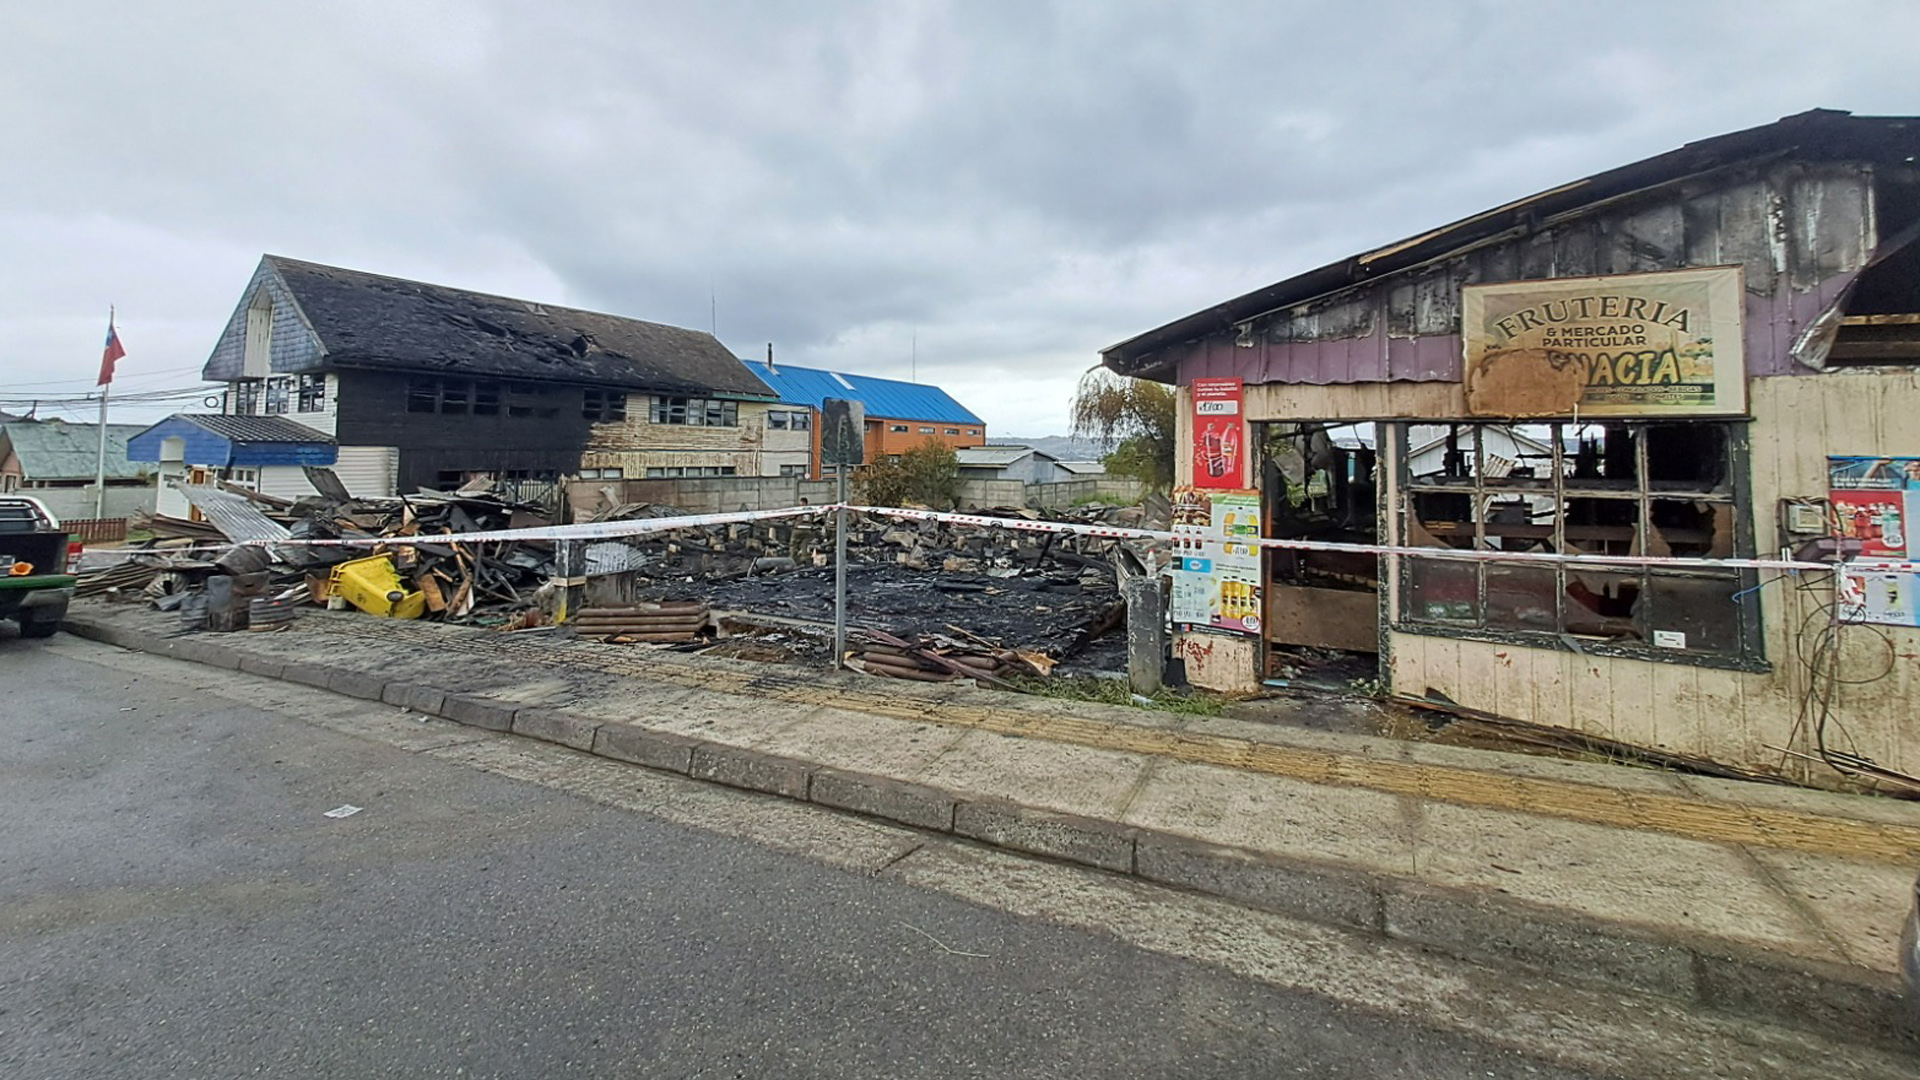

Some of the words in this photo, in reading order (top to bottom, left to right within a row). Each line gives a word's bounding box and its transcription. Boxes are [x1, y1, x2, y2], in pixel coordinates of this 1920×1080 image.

[1496, 296, 1690, 340] FRUTERIA
[1546, 327, 1557, 337] &
[1562, 324, 1645, 338] MERCADO
[1542, 336, 1648, 348] PARTICULAR
